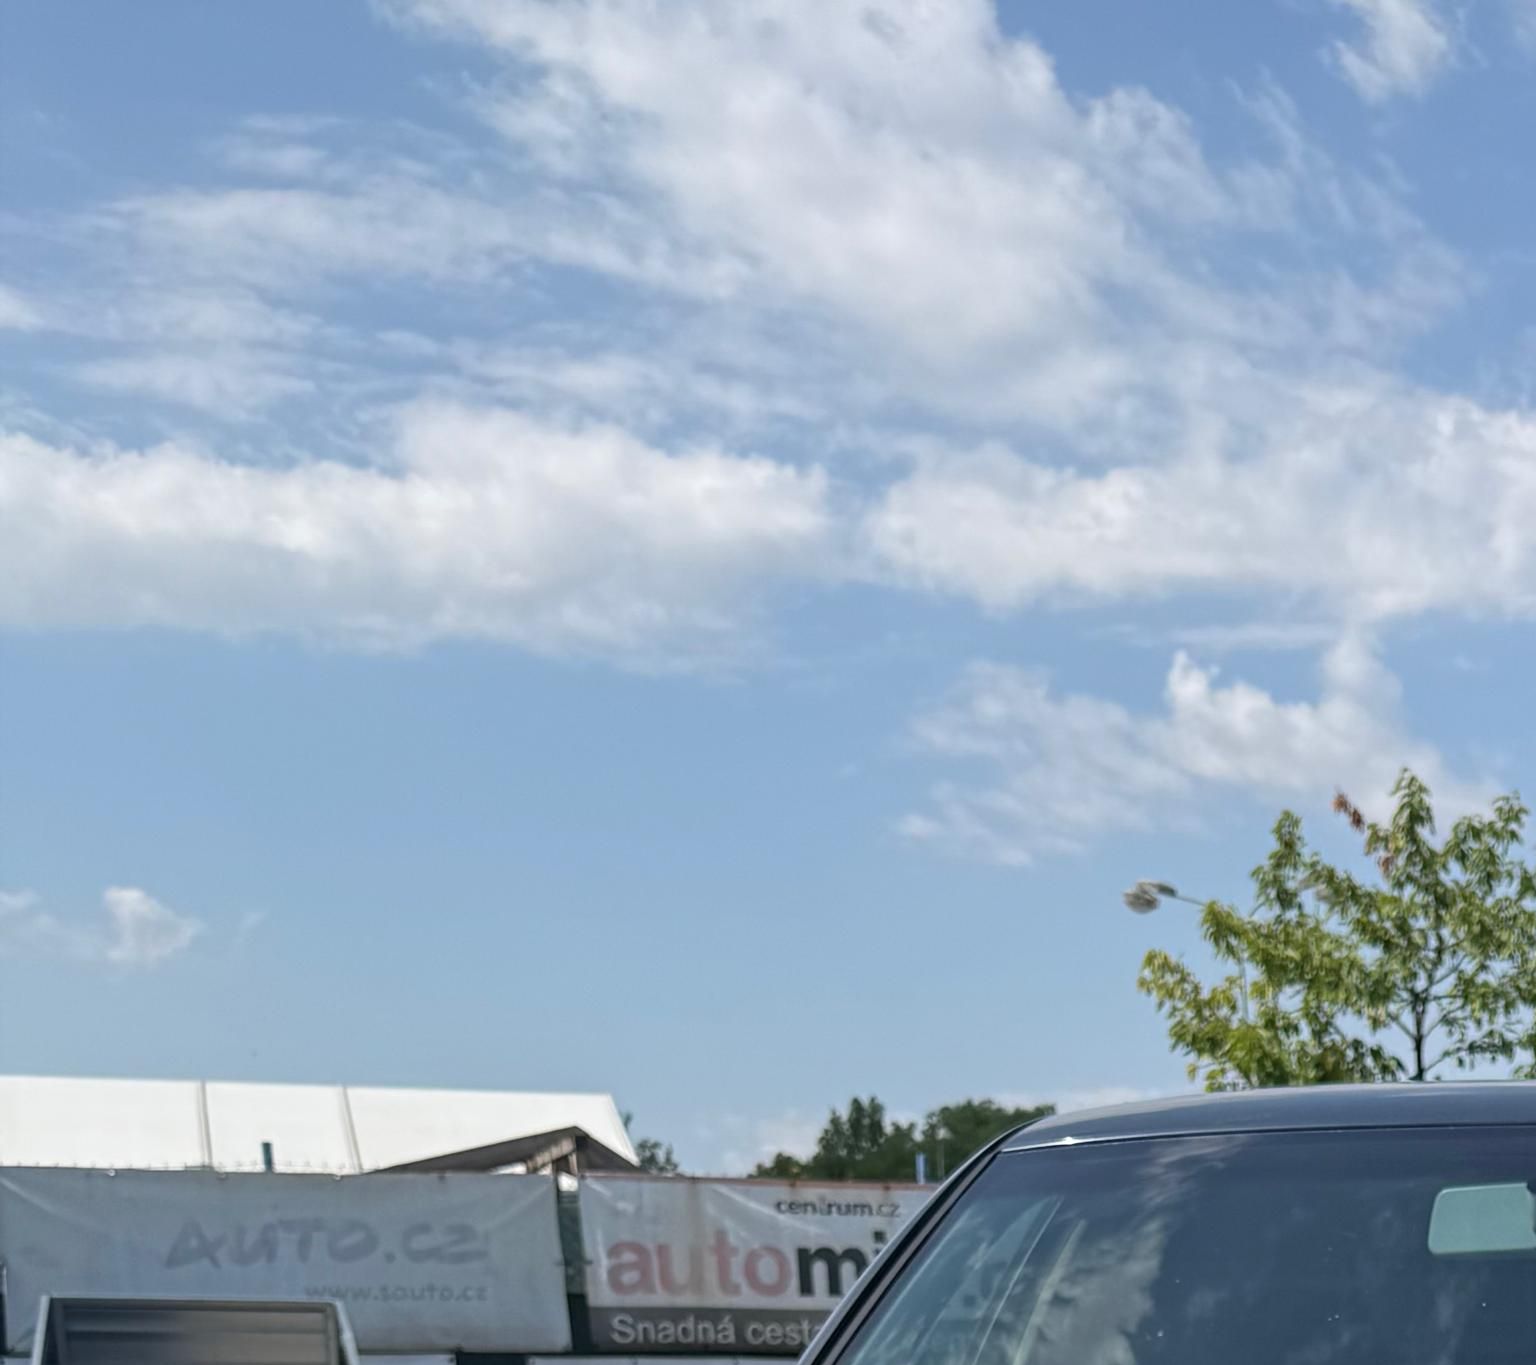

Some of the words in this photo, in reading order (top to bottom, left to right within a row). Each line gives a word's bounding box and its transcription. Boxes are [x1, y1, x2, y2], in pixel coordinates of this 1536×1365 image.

[776, 1196, 901, 1217] centrum.cz
[304, 1282, 488, 1303] www.sauto.cz
[610, 1313, 736, 1344] Snadná
[744, 1318, 823, 1345] cest
